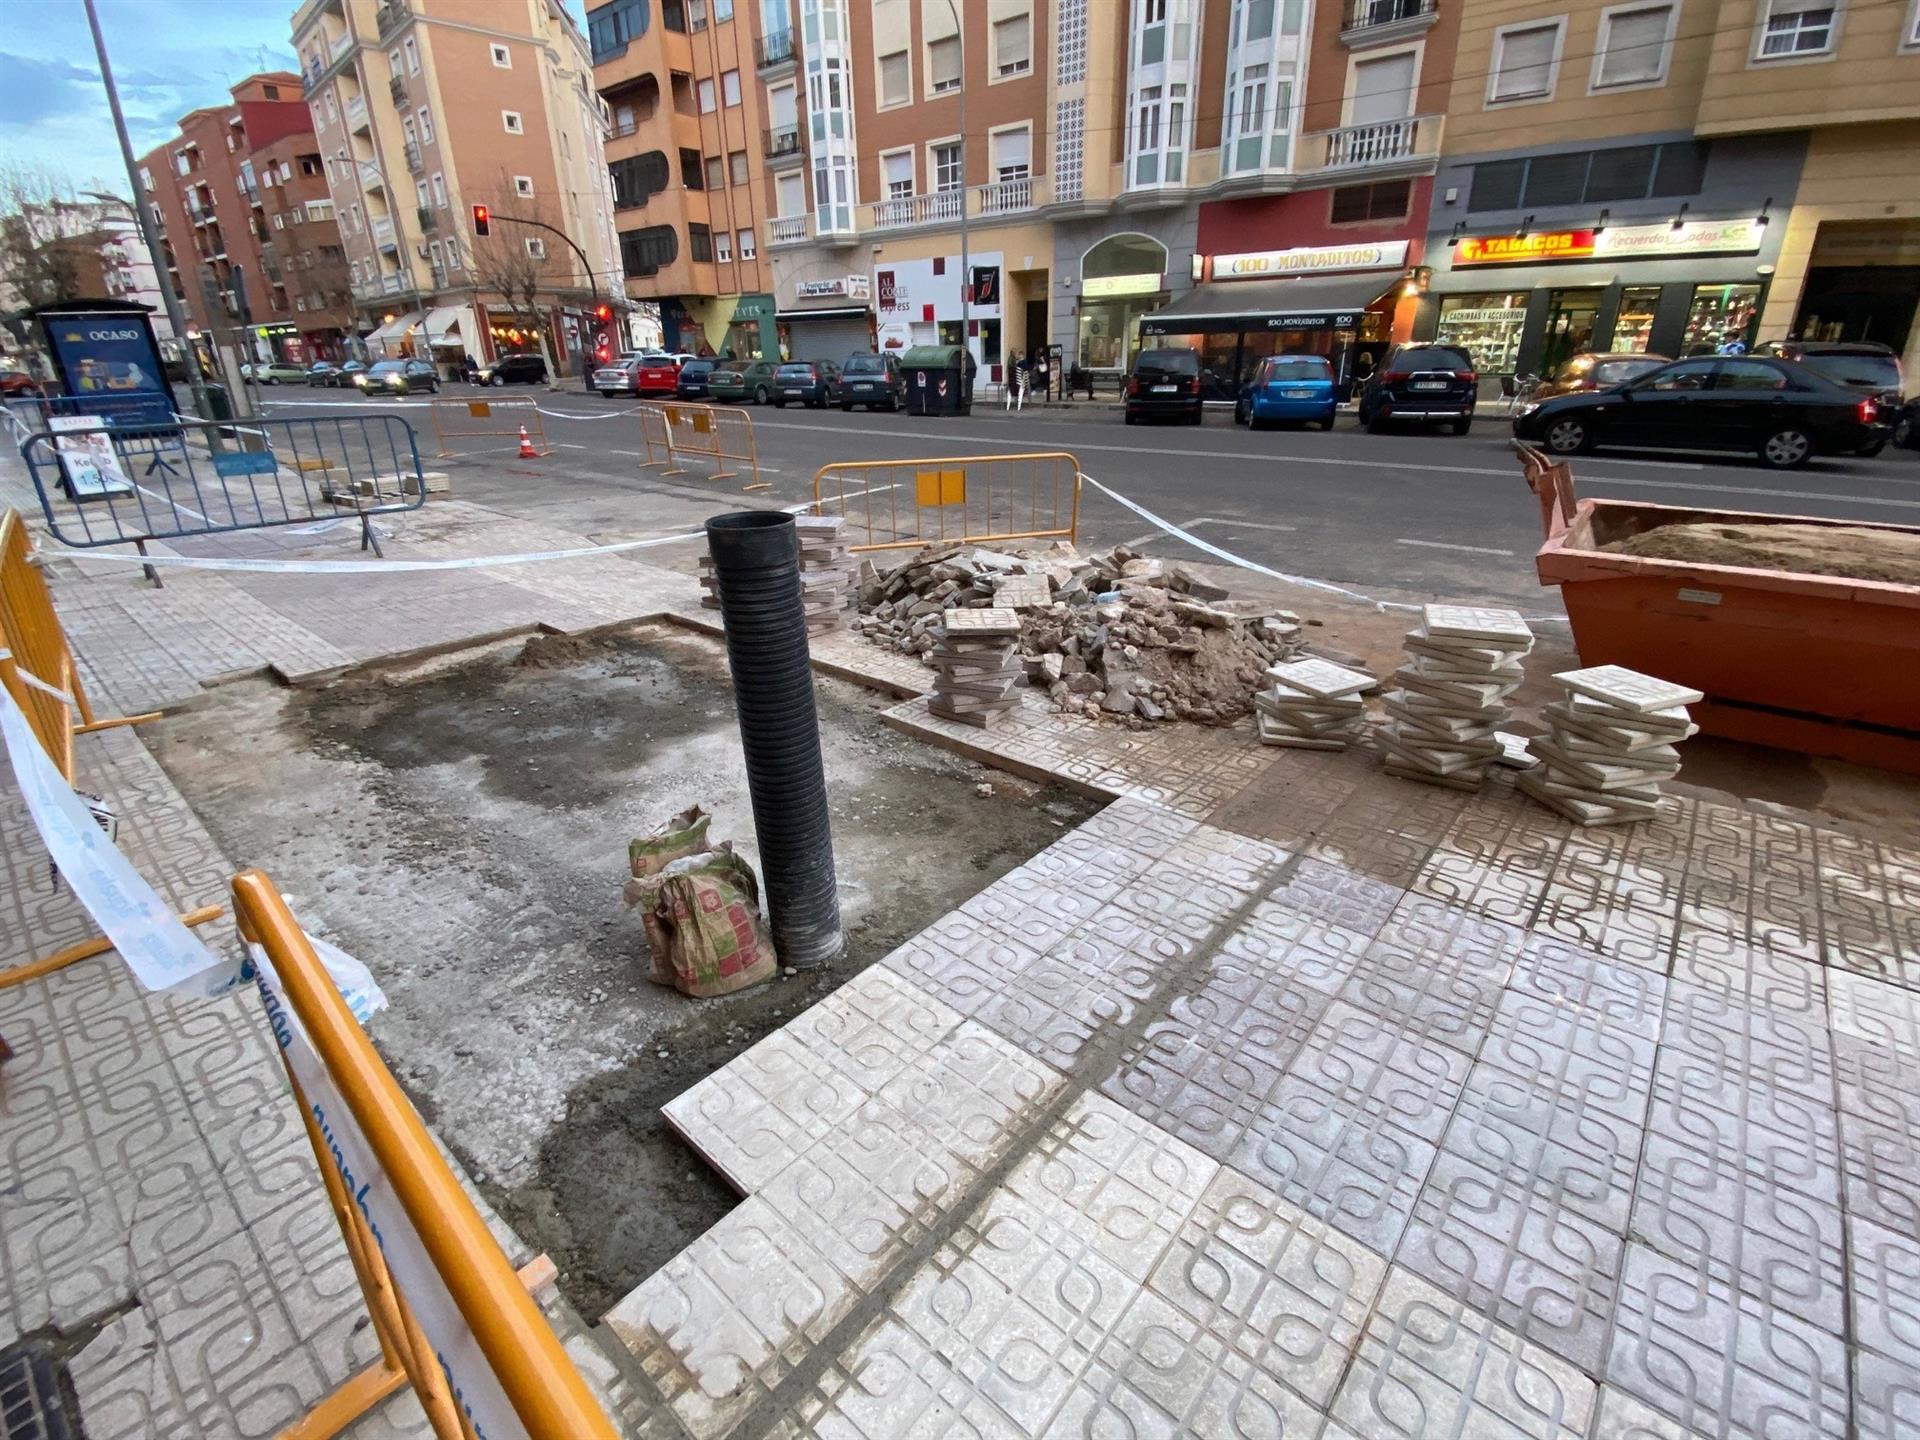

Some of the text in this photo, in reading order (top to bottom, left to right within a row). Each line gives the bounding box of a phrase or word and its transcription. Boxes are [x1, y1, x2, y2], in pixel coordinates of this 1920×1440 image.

[1486, 234, 1573, 253] TABACOS
[1608, 231, 1669, 247] Recuerdos
[1239, 249, 1373, 272] 100 MONTADITOS
[880, 302, 910, 315] express
[1335, 315, 1353, 324] 100
[1450, 312, 1481, 321] CACHIMBAS
[1488, 311, 1524, 320] ACCESORIOS
[1268, 318, 1326, 327] 100 MONTADITOS
[89, 330, 139, 341] OCASO
